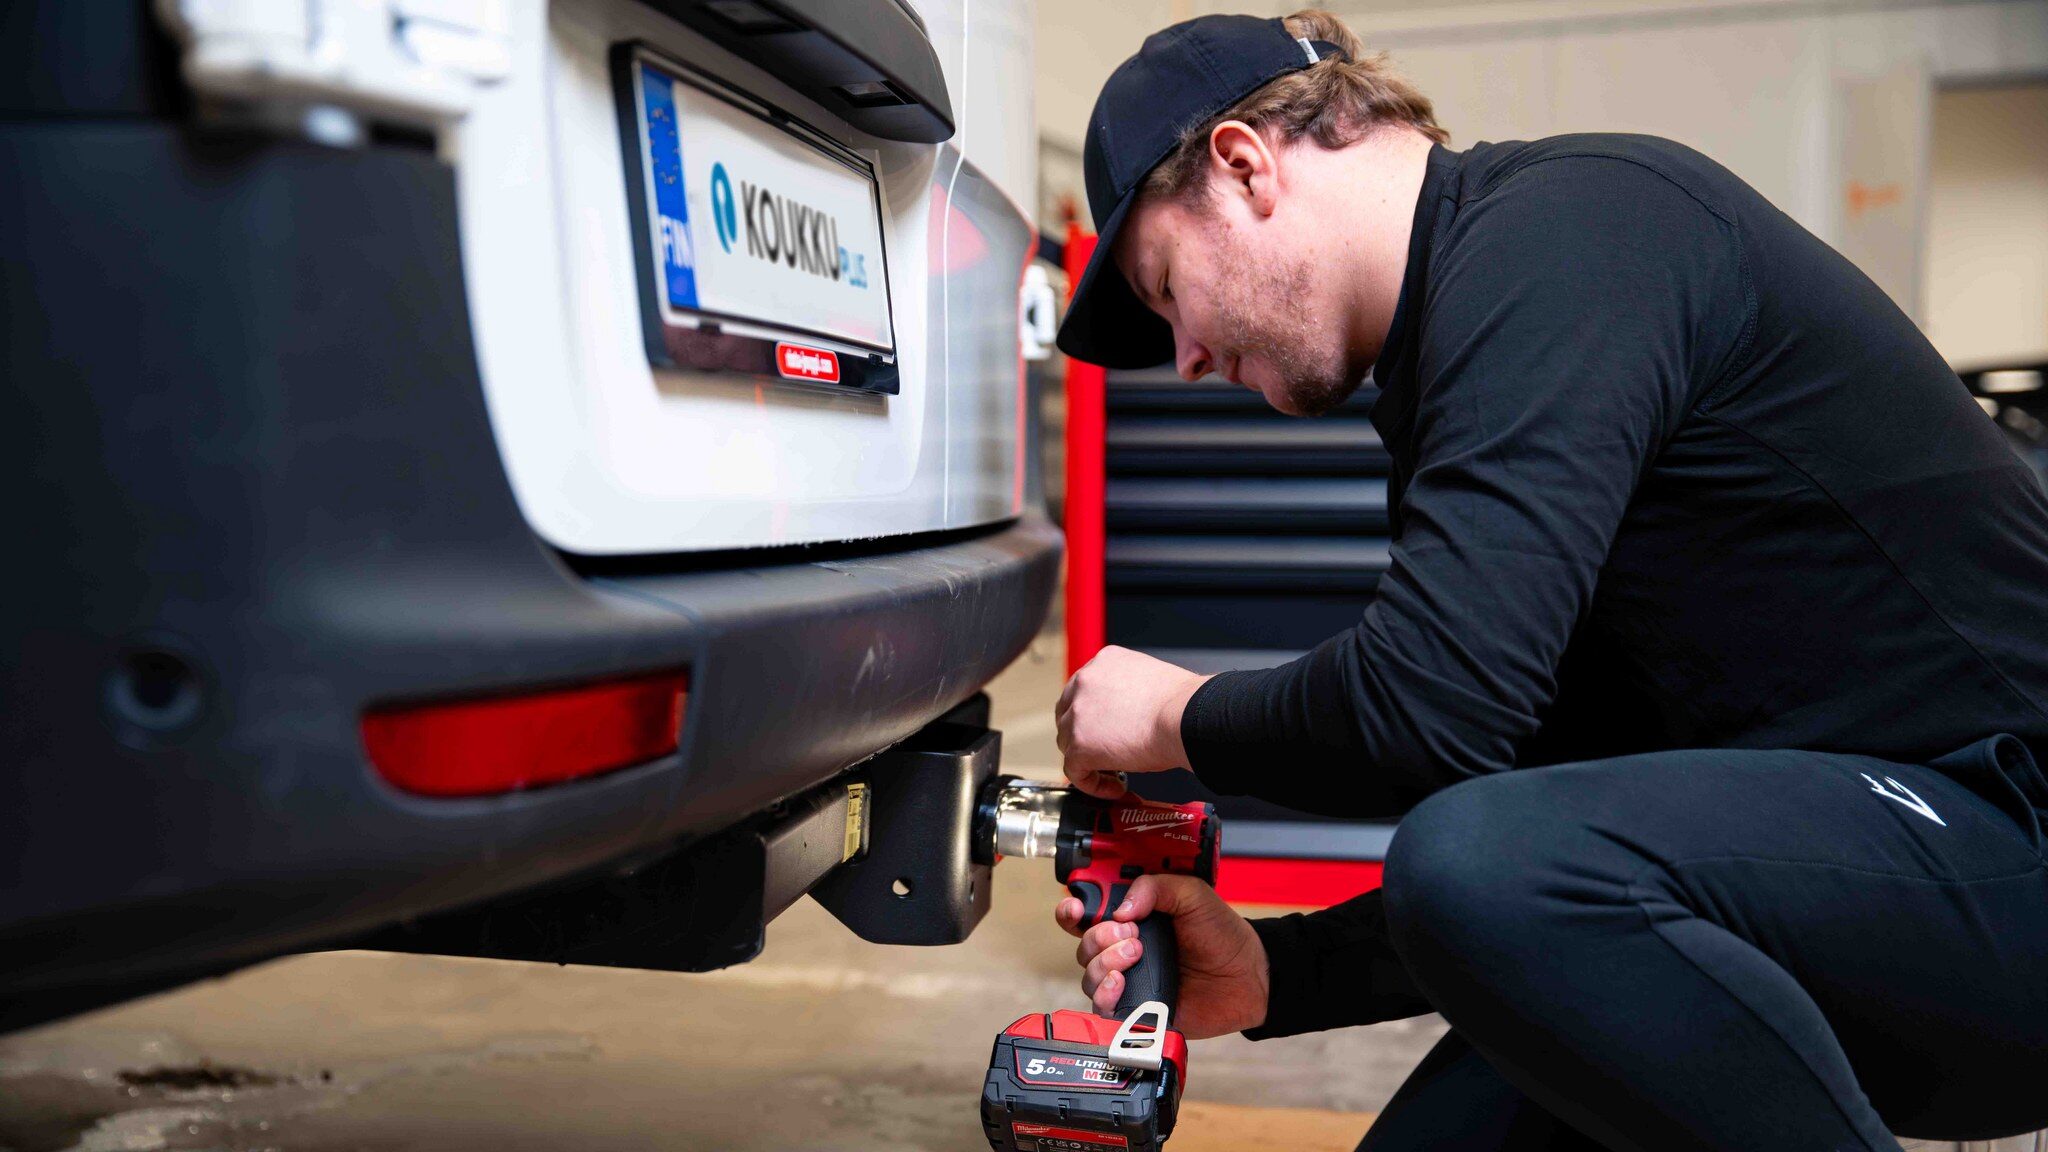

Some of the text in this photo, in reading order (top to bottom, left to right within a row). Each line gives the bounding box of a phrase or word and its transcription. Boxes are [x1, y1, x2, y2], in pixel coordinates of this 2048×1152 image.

[741, 180, 840, 281] KOUKKU
[660, 214, 692, 269] FIN
[1120, 808, 1195, 824] Milwaukee
[1163, 832, 1197, 843] FUEL
[1084, 1069, 1118, 1081] M18
